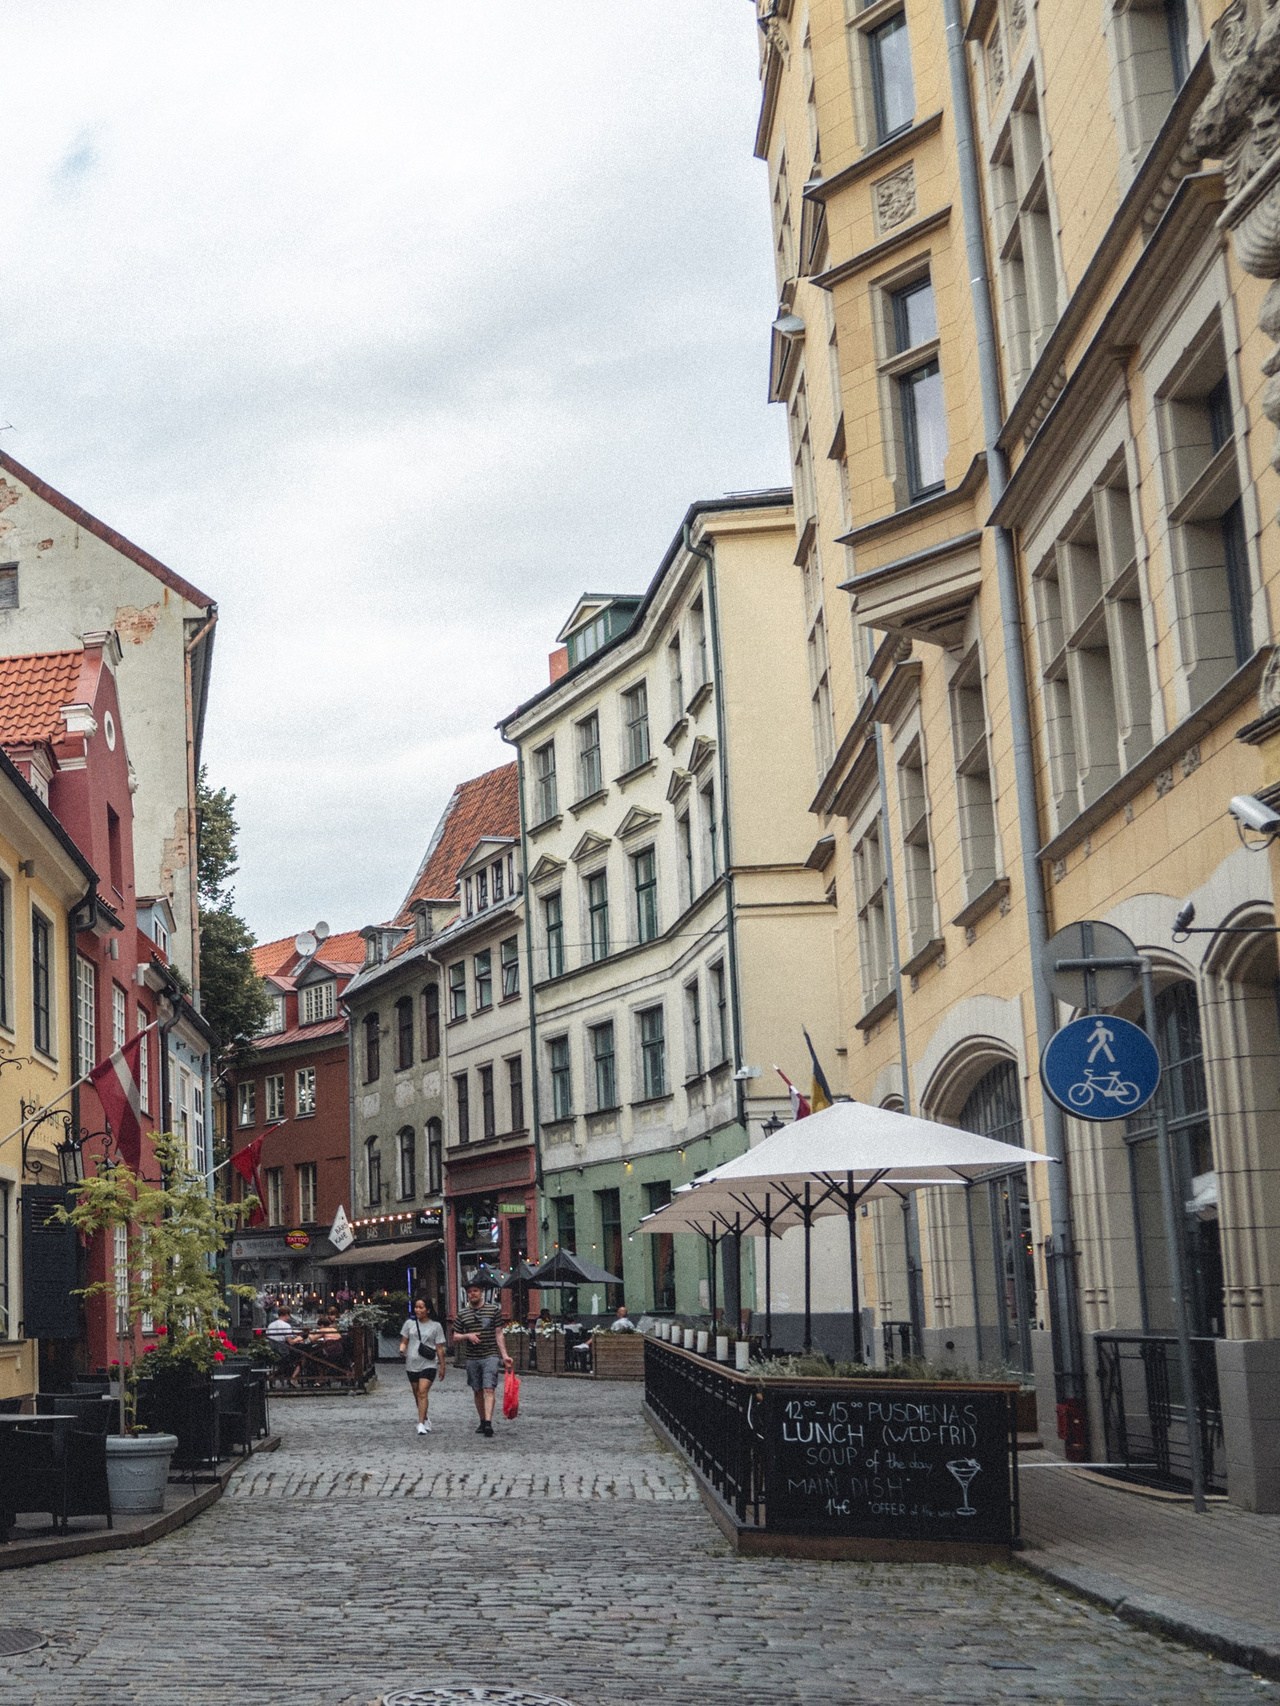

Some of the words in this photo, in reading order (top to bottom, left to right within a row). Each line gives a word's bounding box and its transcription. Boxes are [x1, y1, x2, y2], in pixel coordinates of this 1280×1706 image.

[286, 1236, 310, 1244] TATTOO
[868, 1402, 978, 1426] PUSDIENAS
[782, 1422, 864, 1447] LUNCH
[883, 1425, 976, 1447] (WED-FRI)
[806, 1447, 857, 1465] SOUP
[866, 1449, 879, 1474] of
[886, 1452, 907, 1469] the
[910, 1452, 933, 1477] day
[788, 1478, 839, 1496] MAIN
[825, 1498, 850, 1515] 14€
